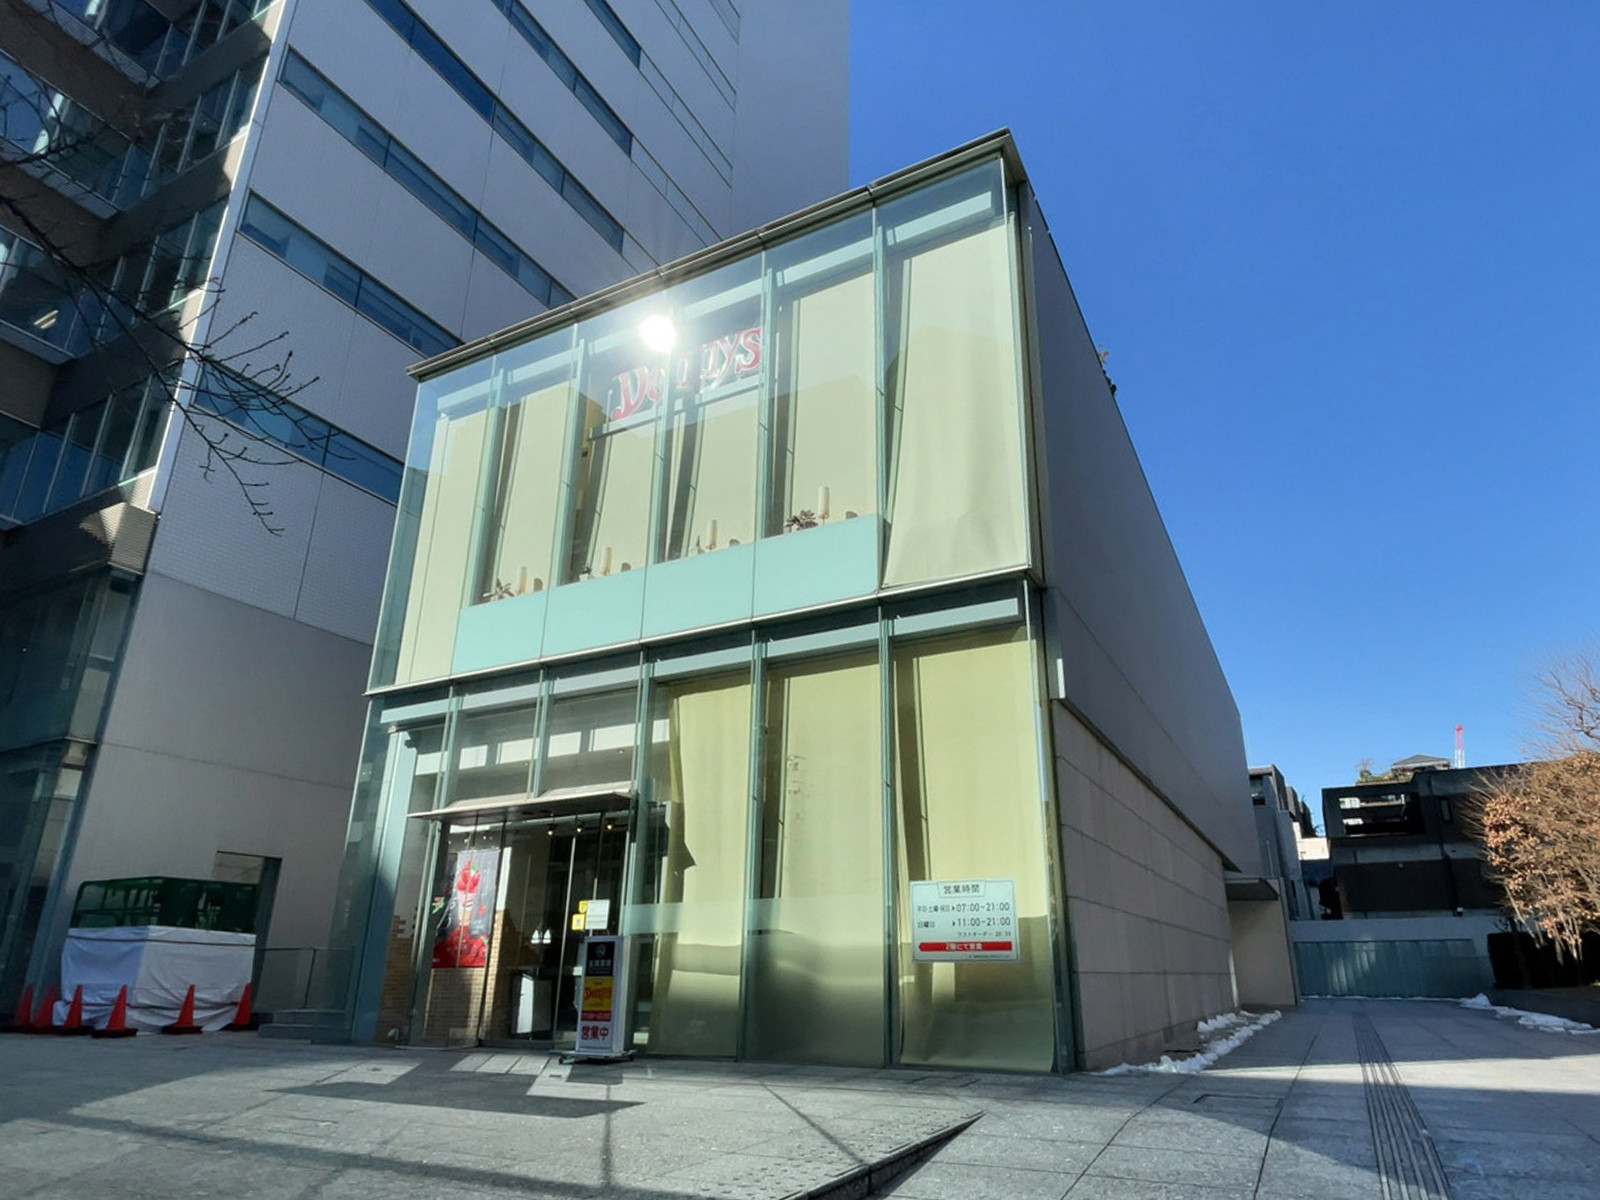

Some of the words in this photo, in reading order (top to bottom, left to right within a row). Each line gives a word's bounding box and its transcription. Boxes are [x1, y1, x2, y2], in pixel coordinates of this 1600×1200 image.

[943, 884, 980, 895] 営業時間
[581, 1025, 609, 1040] 営業中
